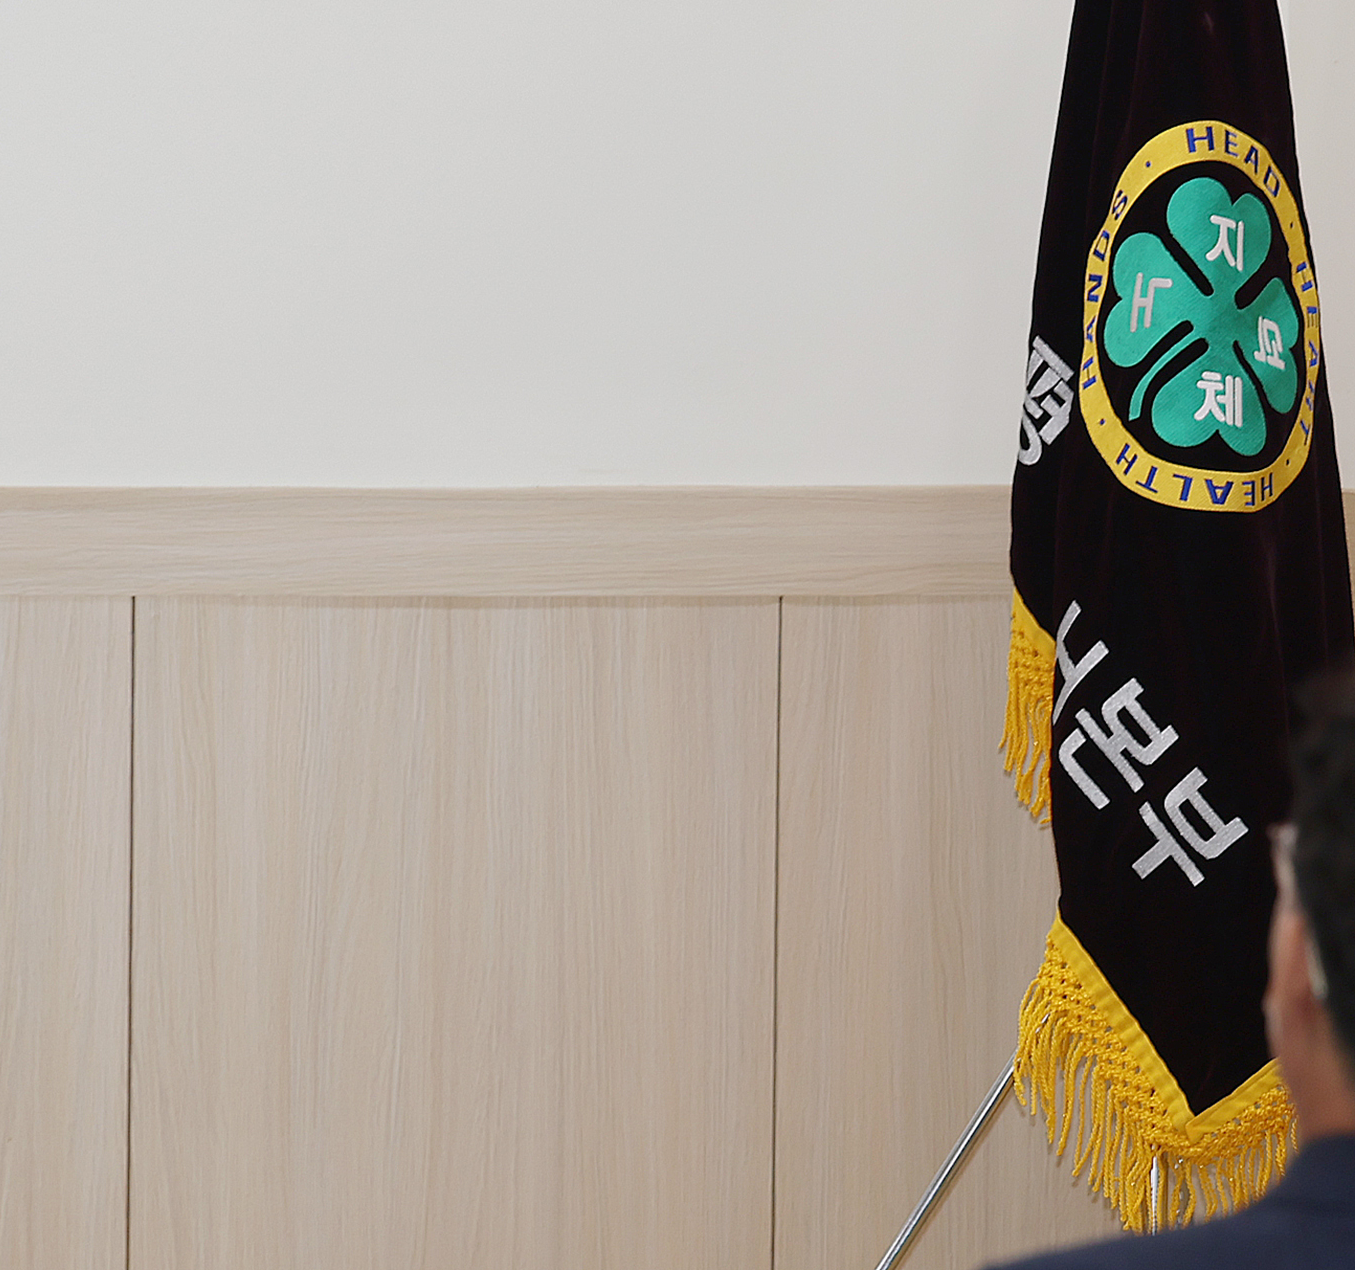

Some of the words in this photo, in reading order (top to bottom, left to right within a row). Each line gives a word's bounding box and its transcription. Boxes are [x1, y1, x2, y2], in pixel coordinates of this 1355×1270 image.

[1185, 126, 1280, 198] HEAD
[1205, 215, 1244, 272] 지
[1081, 189, 1128, 390] HANDS
[1129, 272, 1173, 333] 노
[1194, 371, 1243, 428] 체
[1116, 443, 1274, 507] HEALTH
